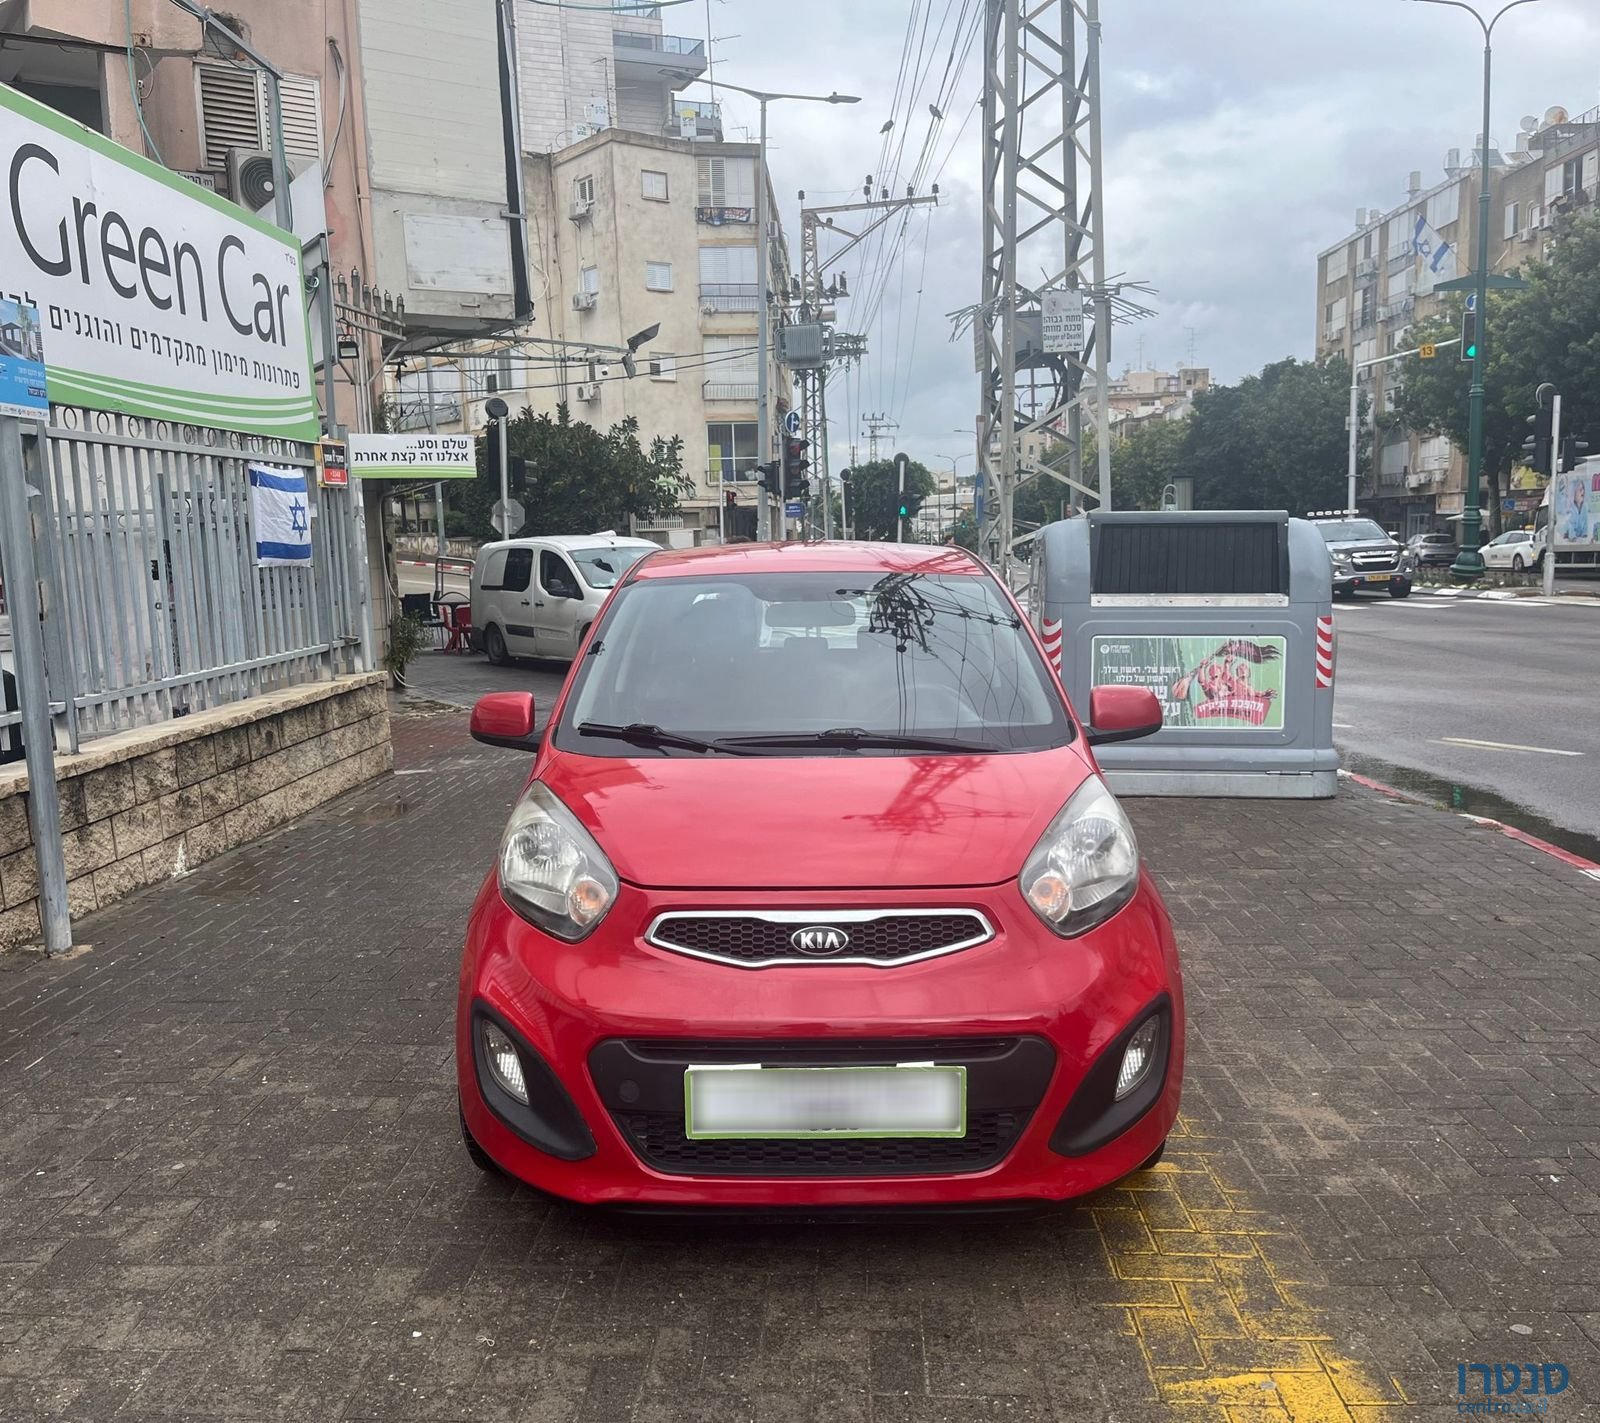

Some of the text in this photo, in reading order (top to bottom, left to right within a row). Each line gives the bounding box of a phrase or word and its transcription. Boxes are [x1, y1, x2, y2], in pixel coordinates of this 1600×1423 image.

[9, 143, 290, 347] Green Car
[1063, 324, 1082, 332] סכנת
[49, 304, 301, 390] פתרונות מימון מתקדמים והוגנים
[1422, 346, 1433, 356] 13
[406, 438, 468, 450] שלם וסע...
[354, 451, 388, 462] אחרת
[391, 452, 416, 465] קצת
[420, 452, 433, 462] זה
[436, 451, 469, 462] אצלנו
[1134, 674, 1145, 682] של
[1146, 675, 1168, 683] ראשון
[799, 932, 840, 949] KIA
